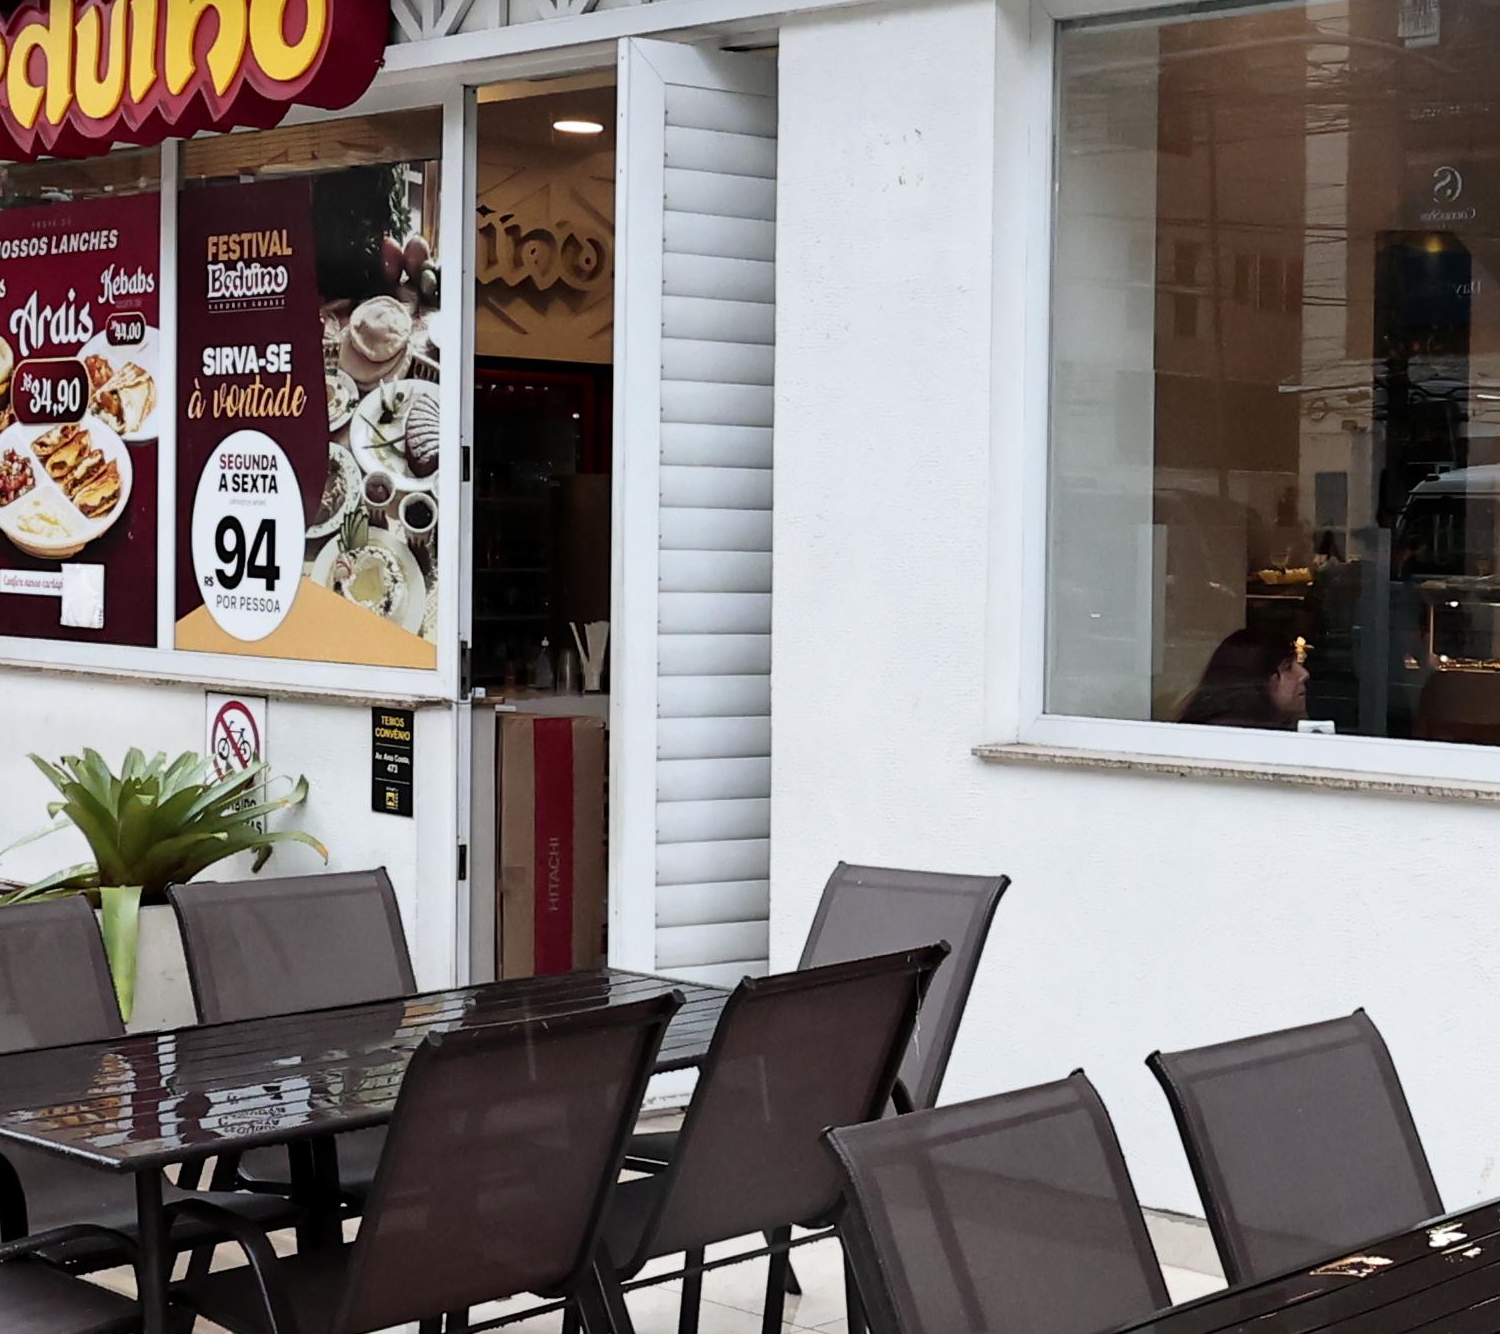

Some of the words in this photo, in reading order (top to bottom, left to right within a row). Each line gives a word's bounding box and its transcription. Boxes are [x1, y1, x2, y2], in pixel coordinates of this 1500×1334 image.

[51, 229, 119, 254] LANCHES
[207, 229, 293, 262] FESTIVAL
[98, 264, 155, 304] Kebabs
[9, 288, 94, 357] Arais
[202, 344, 292, 376] SIRVA-SE
[187, 377, 206, 419] à
[212, 373, 308, 419] vontade
[219, 453, 278, 471] SEGUNDA
[218, 473, 228, 493] A
[231, 473, 279, 494] SEXTA
[214, 515, 281, 592] 94
[216, 595, 237, 610] POR
[239, 595, 281, 613] PESSOA
[380, 714, 405, 728] TEMOS
[548, 837, 560, 911] HITACHI
